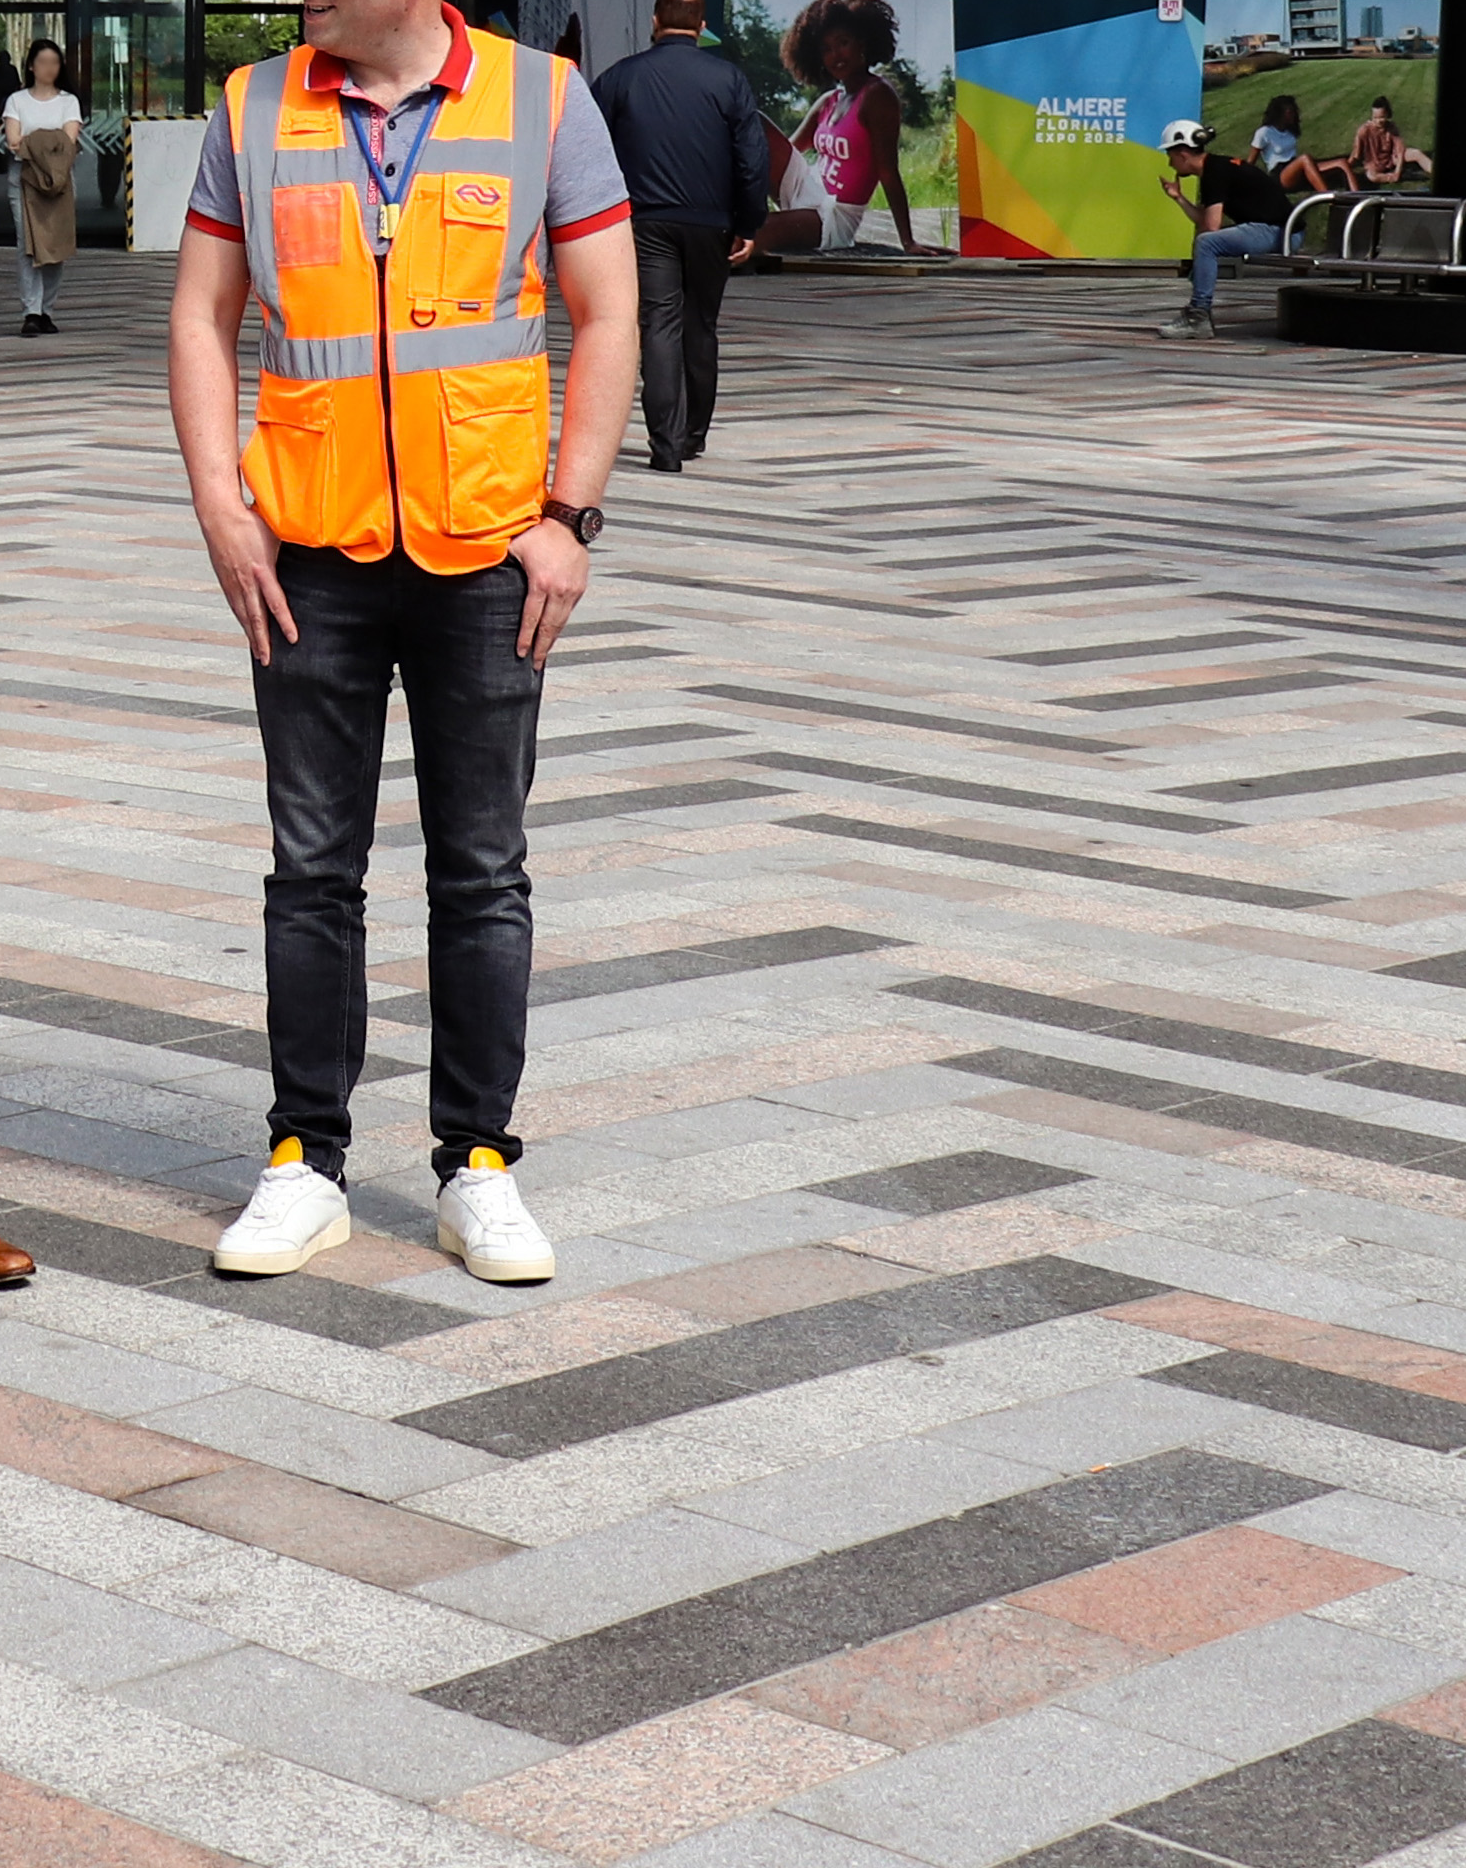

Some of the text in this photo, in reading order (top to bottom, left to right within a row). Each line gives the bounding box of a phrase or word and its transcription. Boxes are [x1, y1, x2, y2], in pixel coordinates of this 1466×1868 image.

[1034, 97, 1127, 117] ALMERE
[1035, 118, 1126, 131] FLORIADE
[1034, 132, 1126, 143] EXPO 2022
